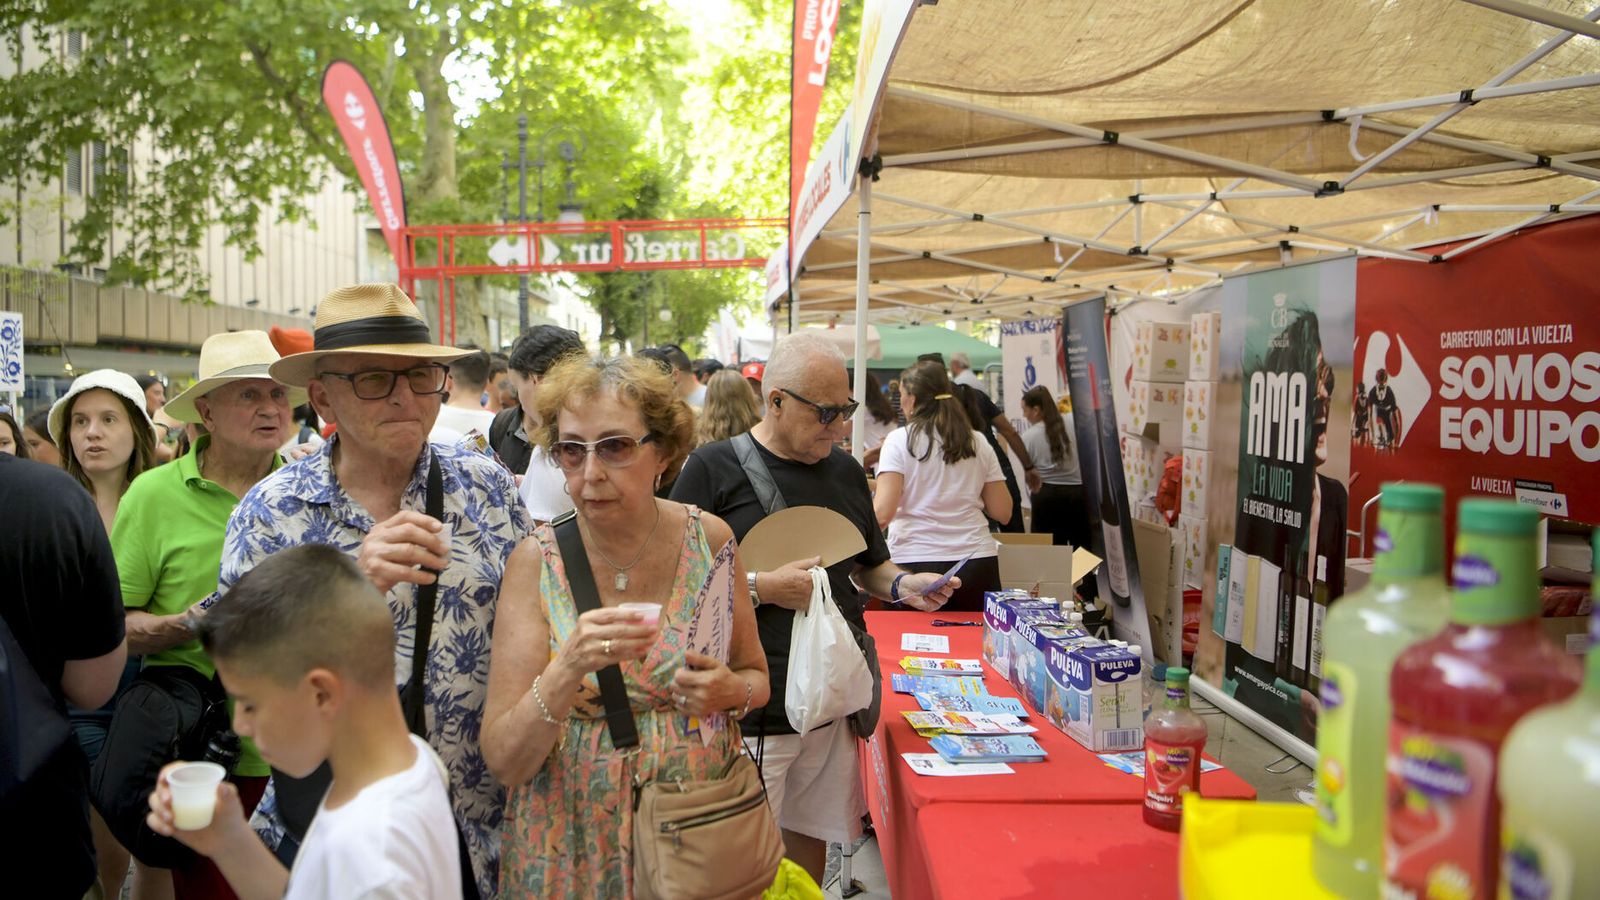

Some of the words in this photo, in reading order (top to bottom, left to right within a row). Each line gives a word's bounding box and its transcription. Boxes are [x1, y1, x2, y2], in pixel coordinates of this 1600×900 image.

[1440, 329, 1493, 349] CARREFOUR
[1494, 327, 1515, 347] CON
[1516, 326, 1530, 346] LA
[1532, 324, 1573, 344] VUELTA
[1439, 351, 1600, 402] SOMOS
[1247, 371, 1307, 464] AMA
[1439, 406, 1600, 463] EQUIPO
[1253, 463, 1267, 496] LA
[1269, 466, 1293, 503] VIDA
[1481, 477, 1512, 495] VUELTA
[1243, 497, 1249, 514] EL
[1276, 507, 1284, 524] LA
[1284, 509, 1302, 529] SALUD
[986, 597, 1007, 625] PULEVA
[1015, 615, 1037, 645] PULEVA
[1051, 646, 1084, 681] PULEVA
[1100, 659, 1135, 671] PULEVA
